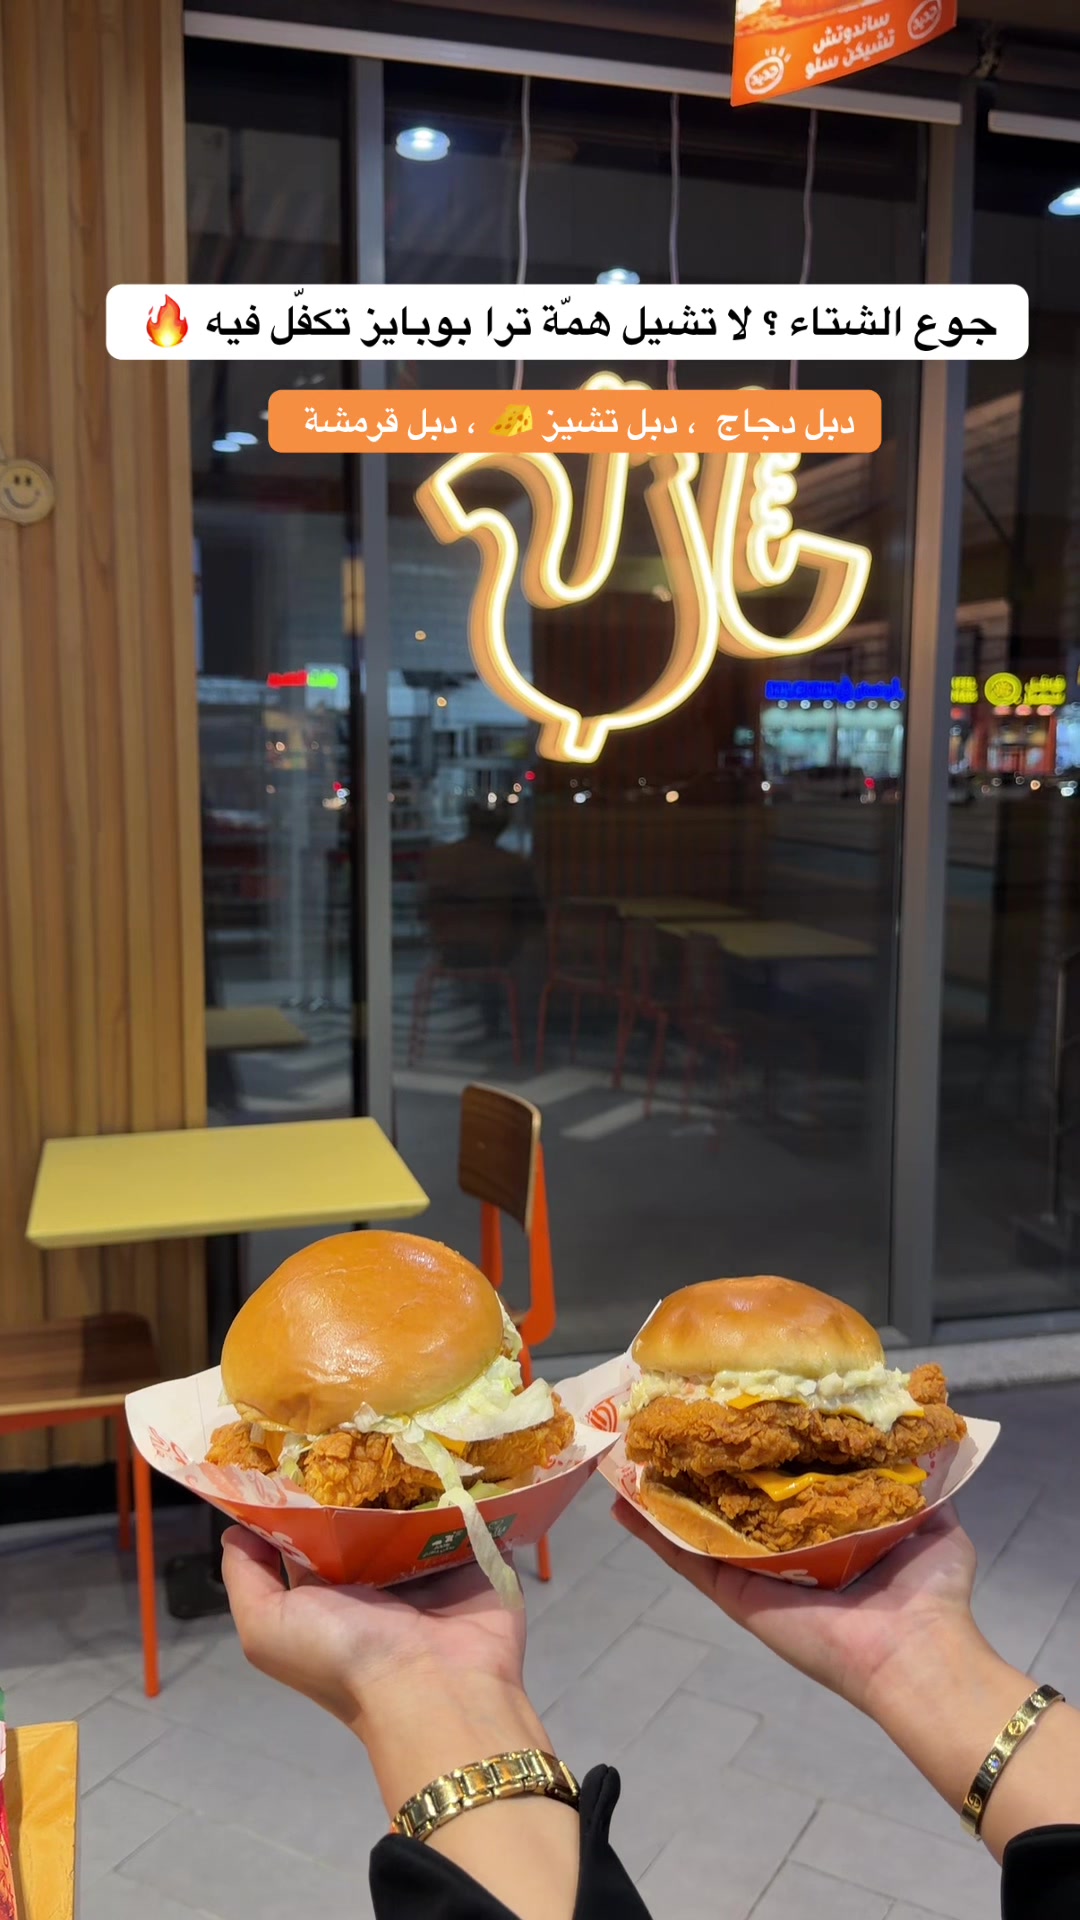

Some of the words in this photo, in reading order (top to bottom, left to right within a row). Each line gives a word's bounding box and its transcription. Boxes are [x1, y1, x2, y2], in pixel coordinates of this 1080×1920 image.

[812, 13, 891, 55] ساندوتش
[842, 29, 896, 67] تشيكن
[750, 64, 780, 87] جديد
[804, 55, 840, 81] سلو
